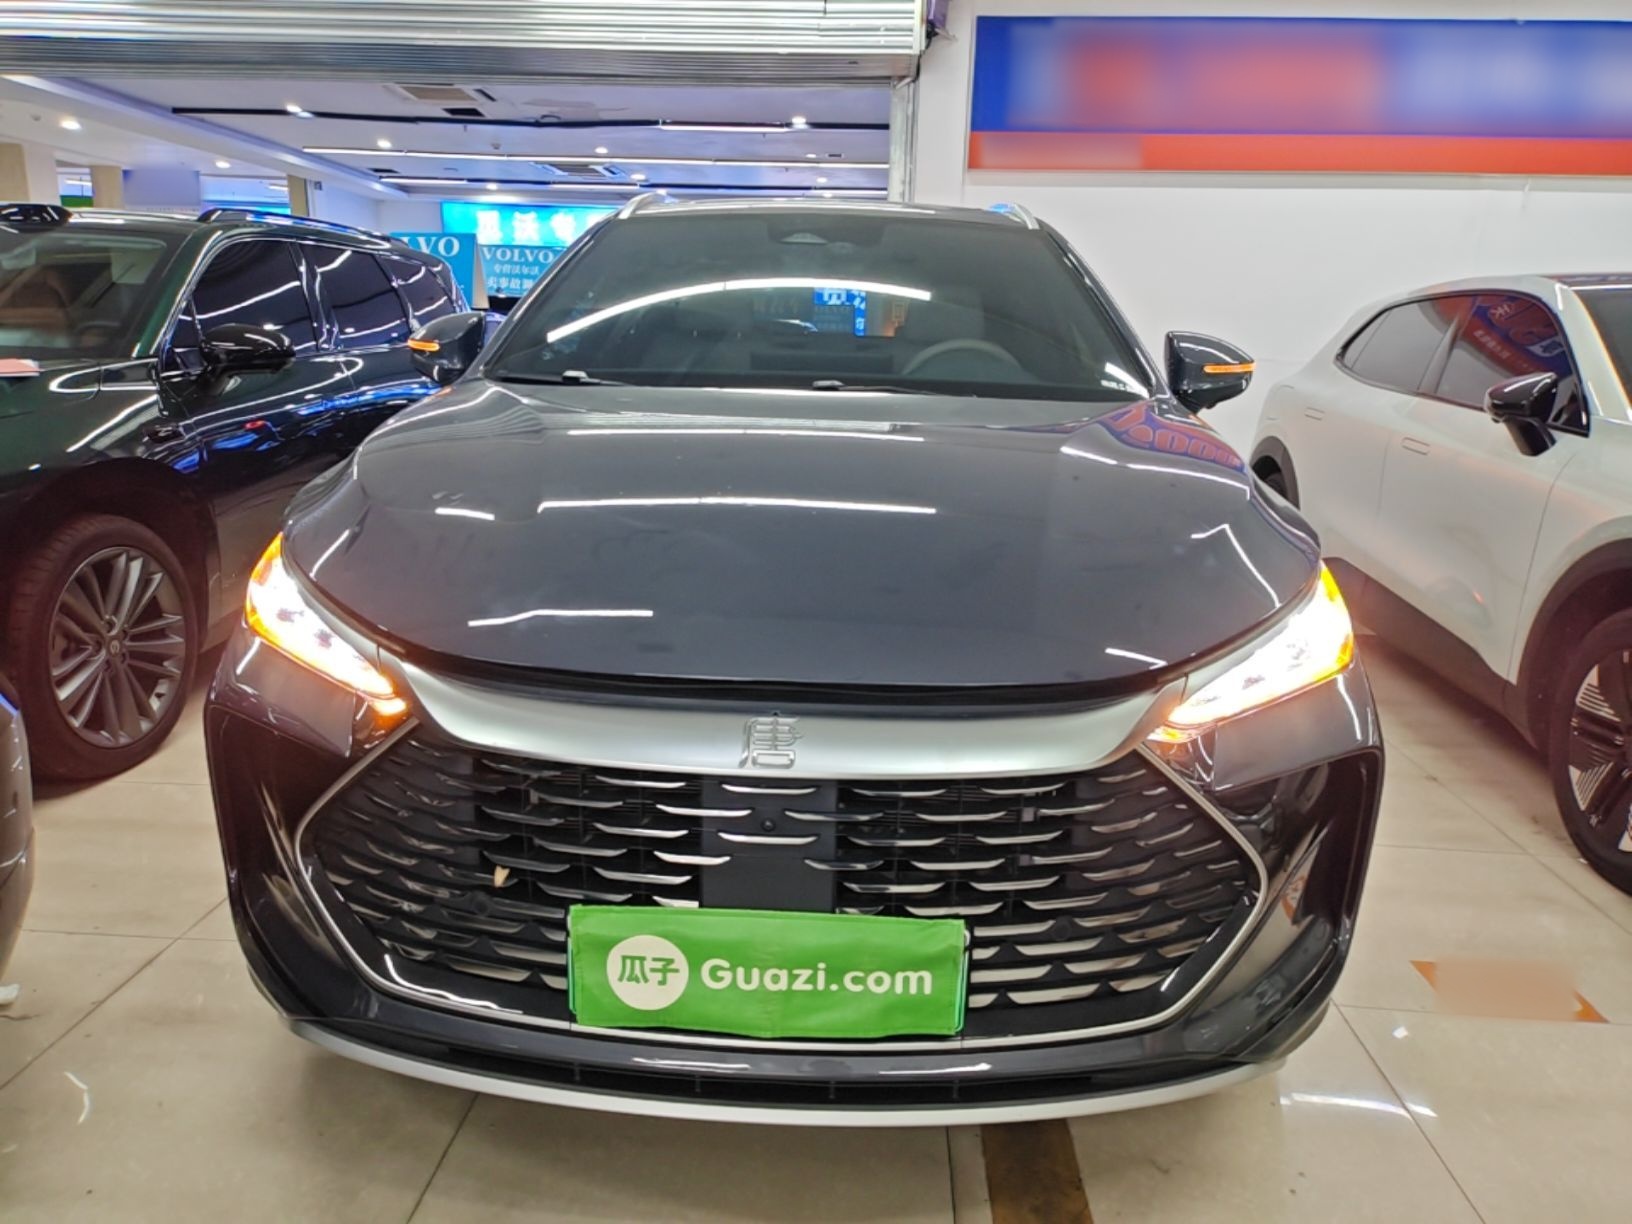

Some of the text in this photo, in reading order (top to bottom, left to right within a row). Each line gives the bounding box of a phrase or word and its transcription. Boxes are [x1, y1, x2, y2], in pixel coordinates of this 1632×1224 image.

[482, 247, 554, 264] VOLVO
[618, 955, 933, 995] 瓜子 Guazi.com
